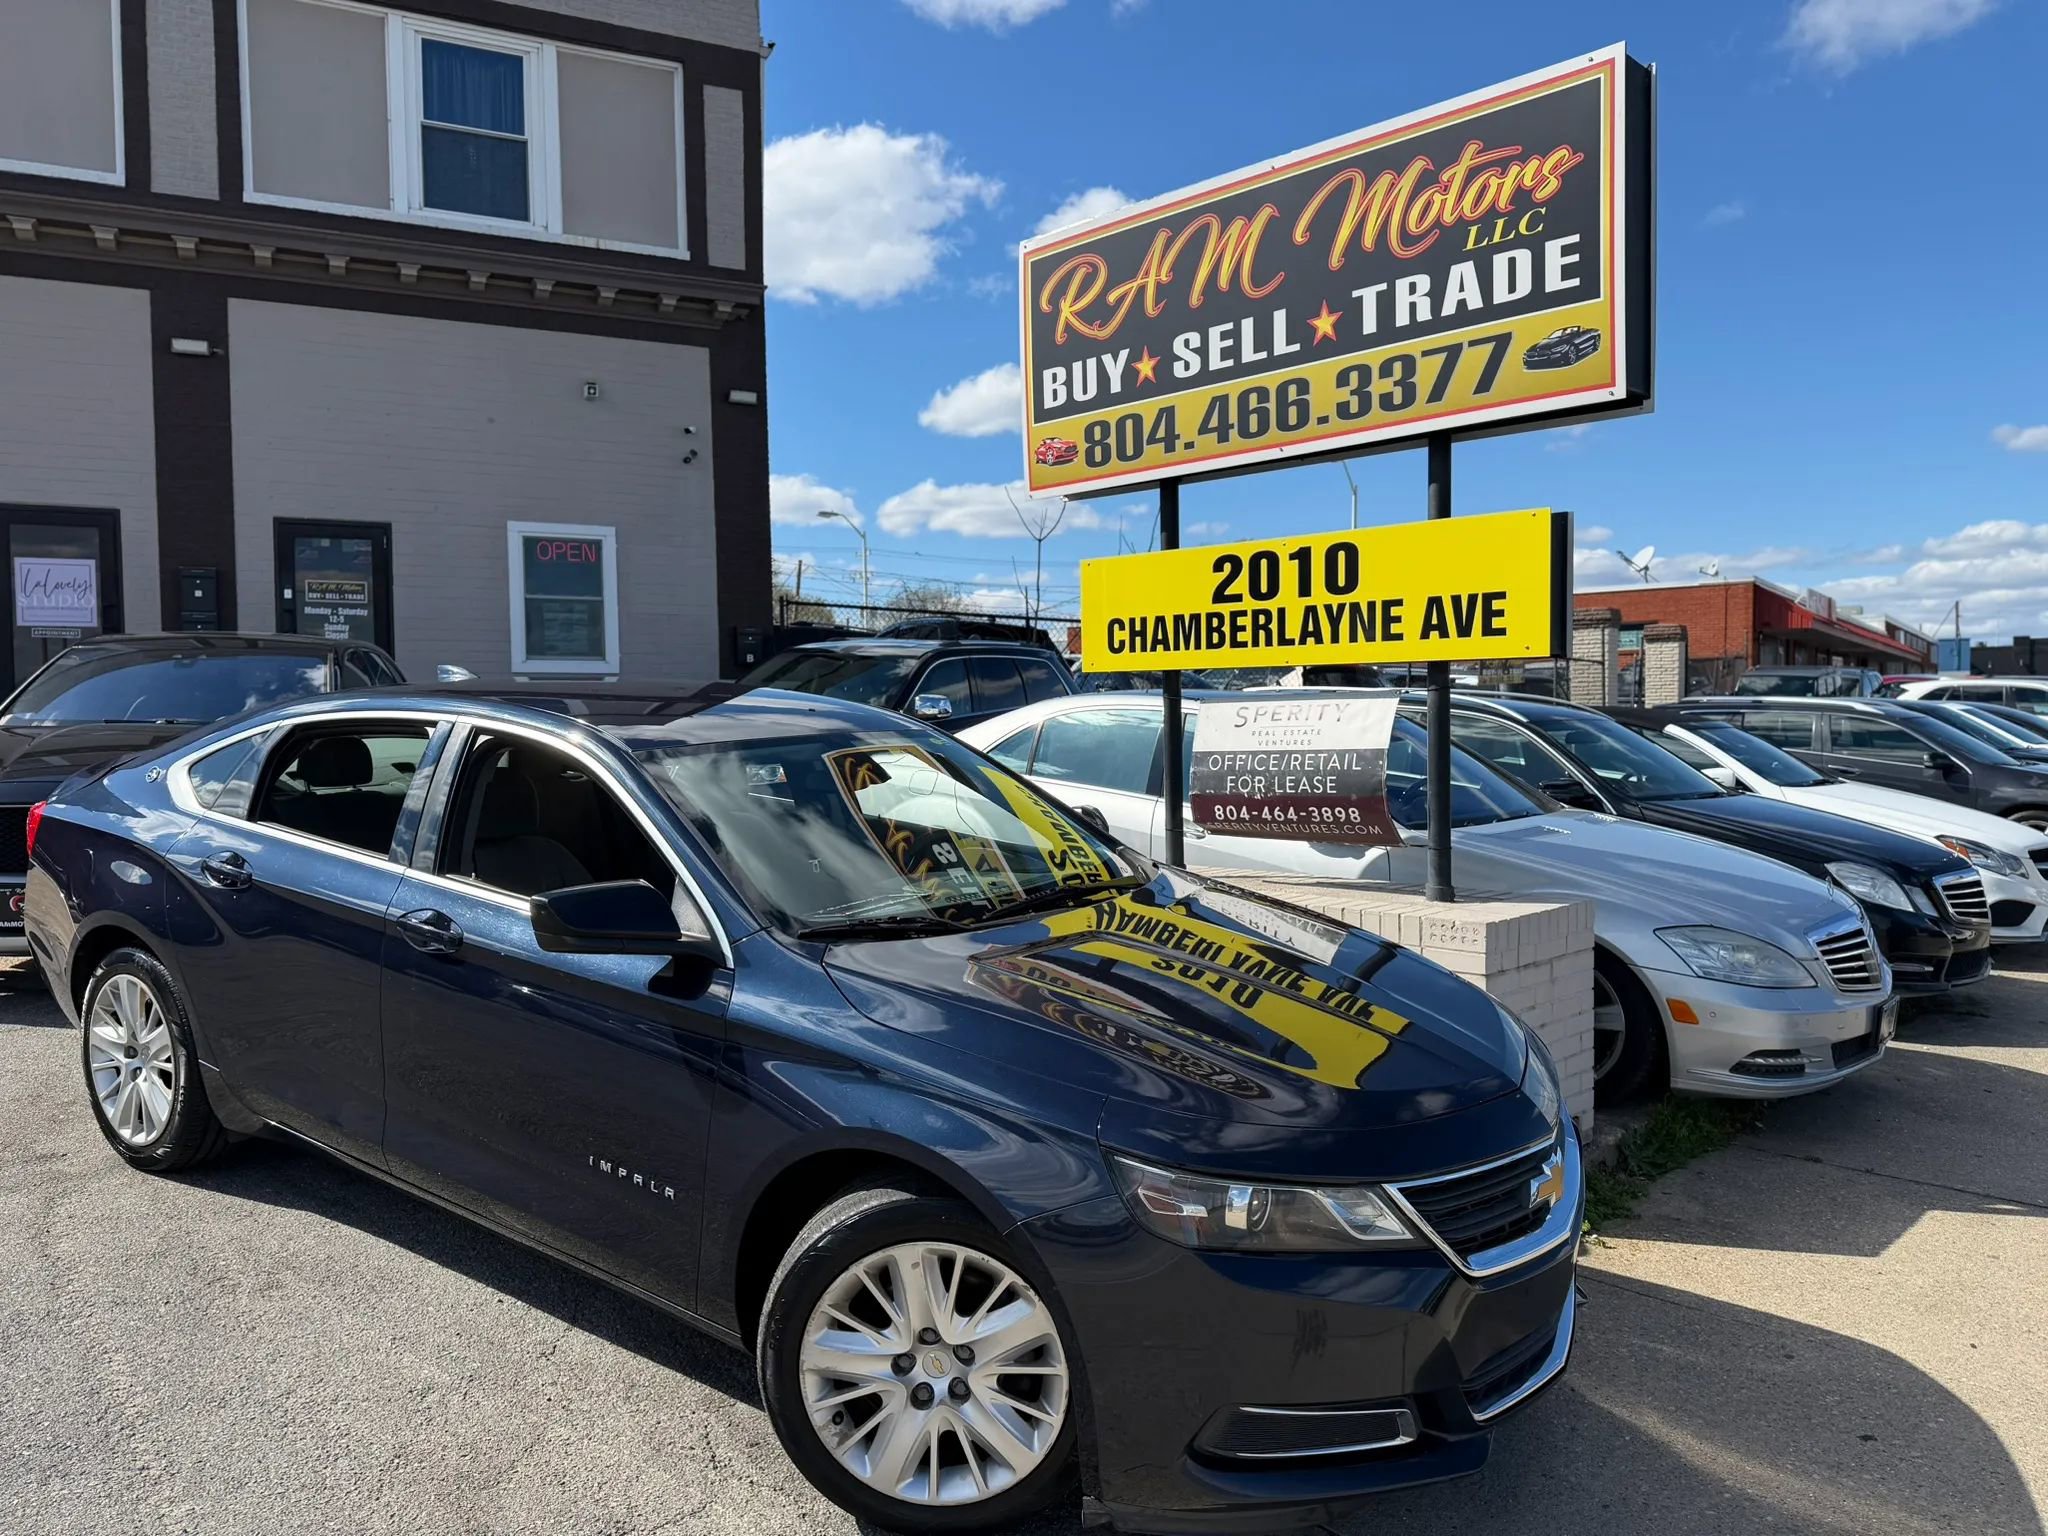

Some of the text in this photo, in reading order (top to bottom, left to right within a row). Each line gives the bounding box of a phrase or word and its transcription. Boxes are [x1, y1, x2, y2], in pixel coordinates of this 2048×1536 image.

[1462, 207, 1547, 251] LLC
[1039, 140, 1584, 345] RAM Motors
[1042, 233, 1581, 410] BUY SELL TRADE
[1084, 331, 1514, 469] 804.466.3377
[536, 540, 597, 562] OPEN
[1211, 541, 1359, 605] 2010
[304, 606, 332, 615] Monday
[338, 607, 368, 616] Saturday
[1107, 591, 1507, 655] CHAMBERLAYNE AVE
[324, 623, 349, 632] Sunday
[1234, 703, 1350, 728] SPERITY
[1252, 728, 1322, 737] REAL ESTATE
[1208, 753, 1362, 771] OFFICE/RETAIL
[1227, 775, 1338, 793] FOR LEASE
[1214, 804, 1362, 823] 804-464-3898
[589, 1155, 675, 1201] IMPALA
